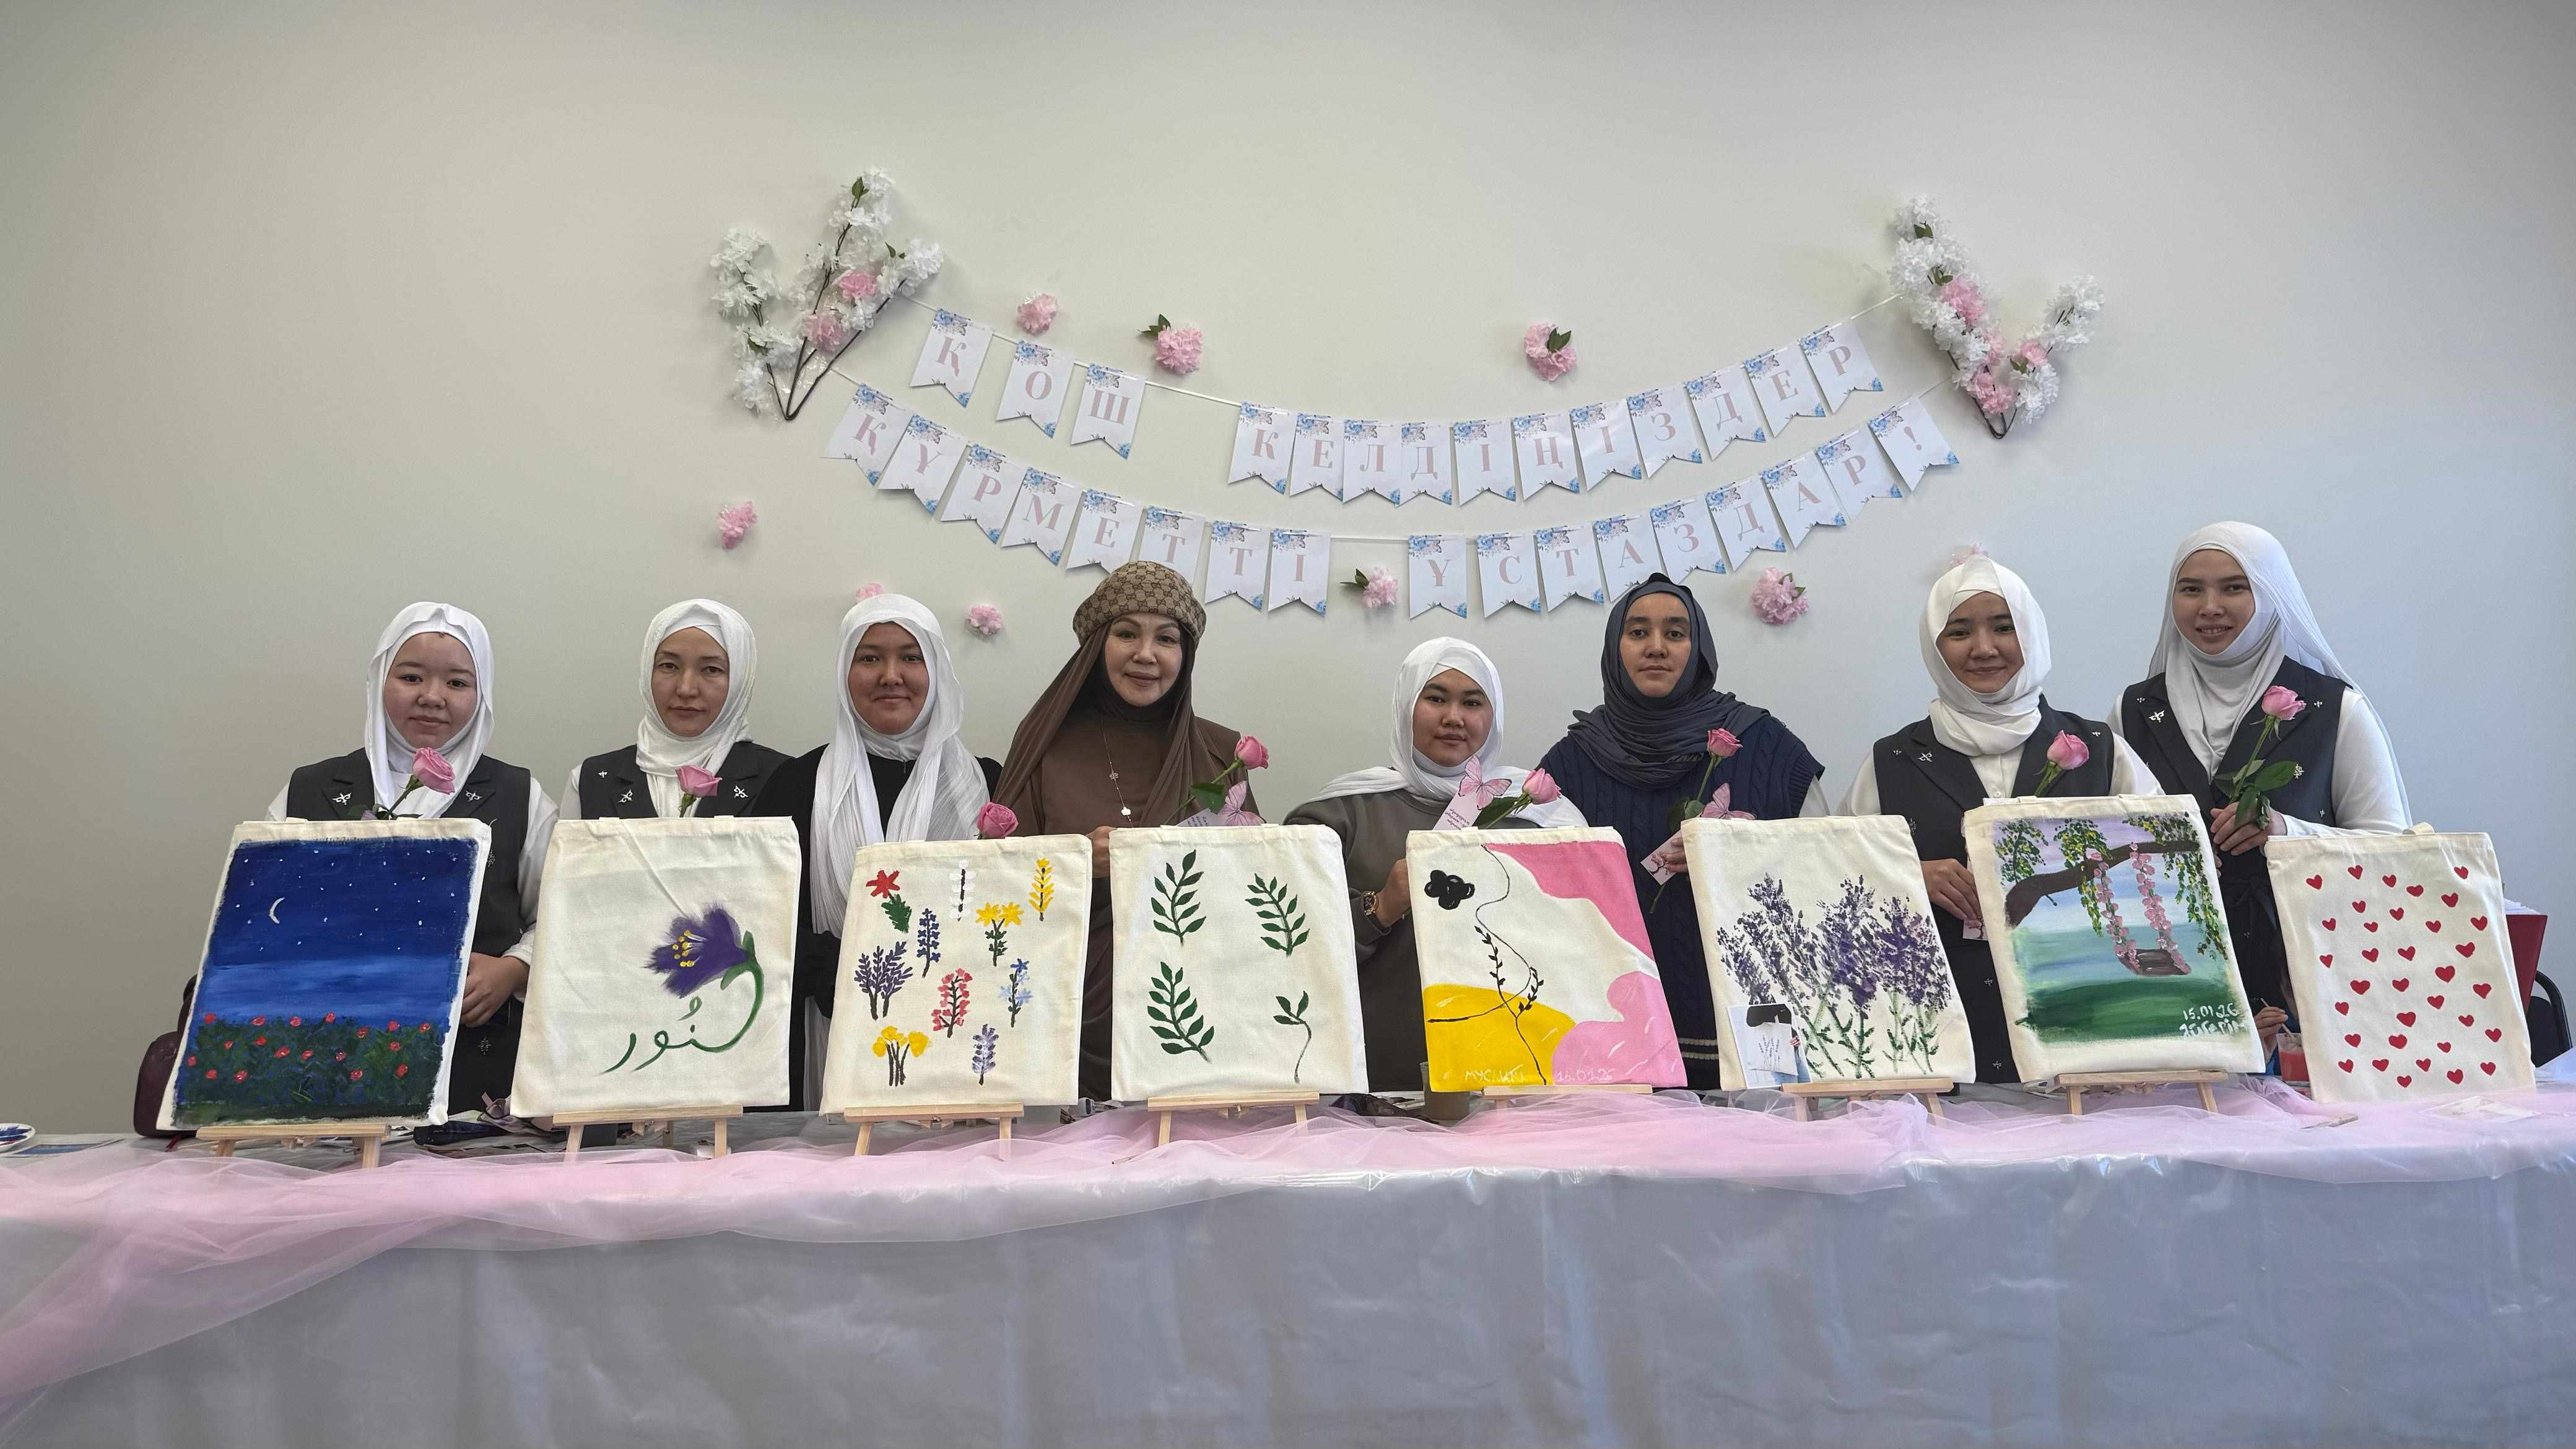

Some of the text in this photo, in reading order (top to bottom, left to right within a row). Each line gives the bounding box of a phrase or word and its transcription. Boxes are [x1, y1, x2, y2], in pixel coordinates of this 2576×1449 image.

[935, 337, 1852, 481] ҚОШ КЕЛДІҢІЗДЕР
[853, 413, 1923, 587] ҚҰРМЕТТІ ҰСТАЗДАР!
